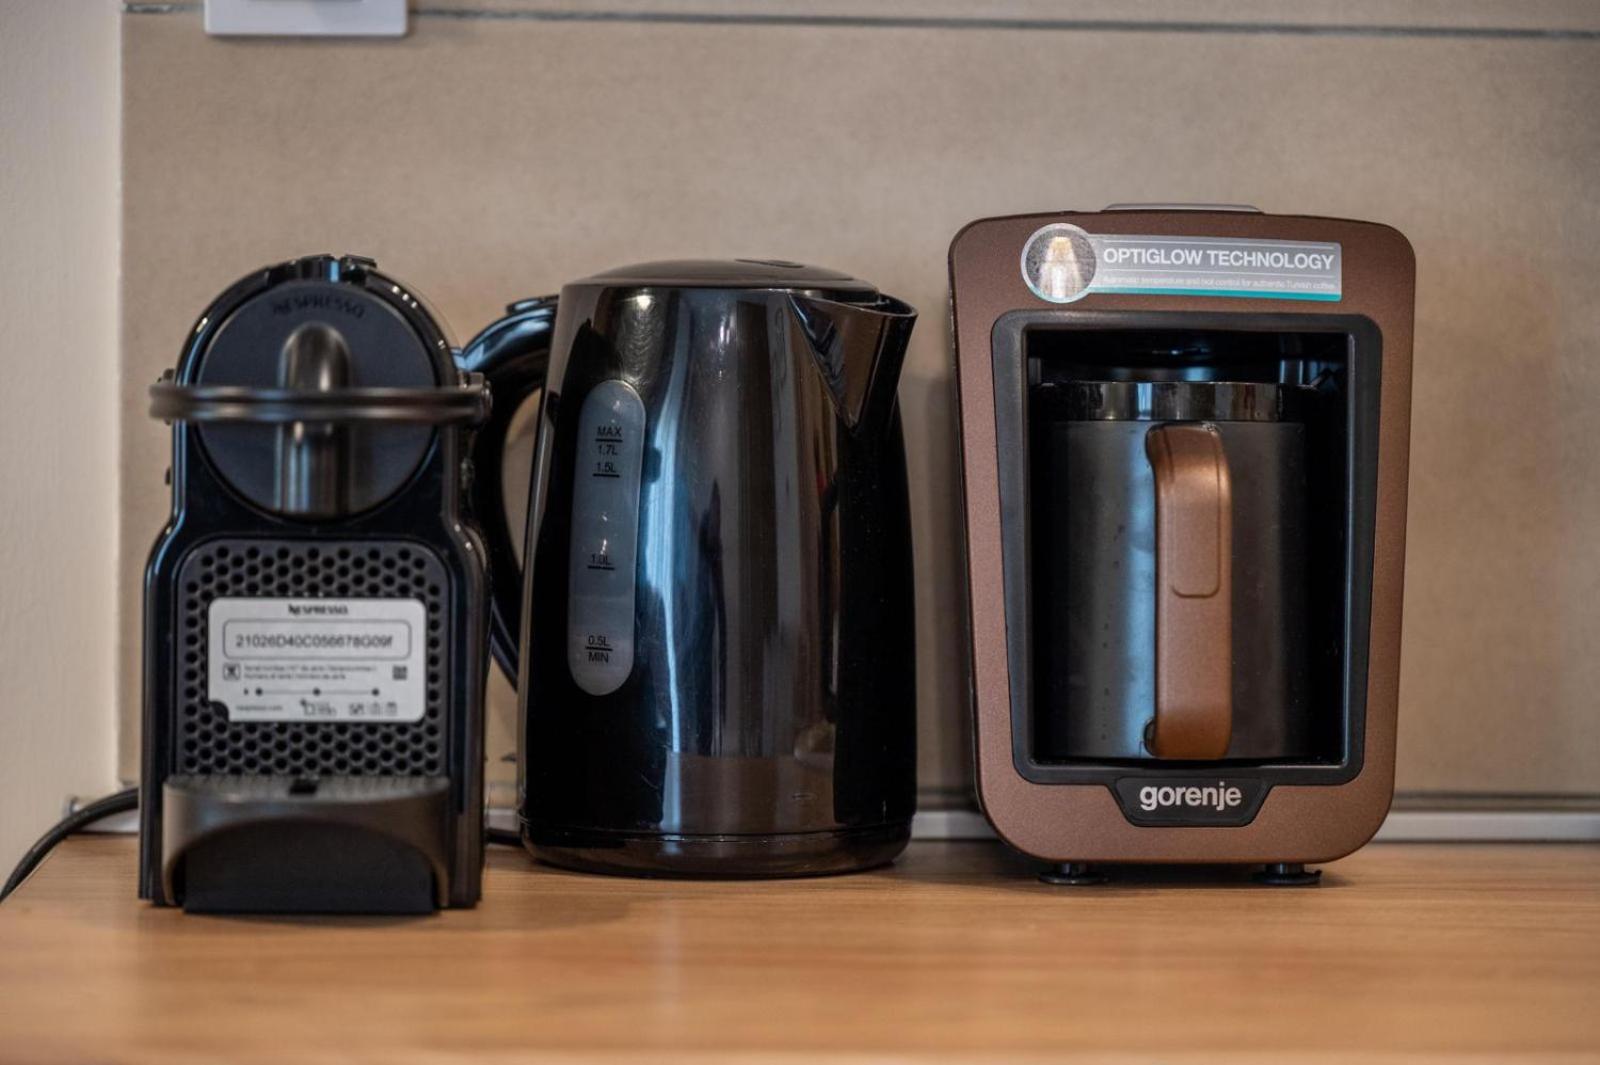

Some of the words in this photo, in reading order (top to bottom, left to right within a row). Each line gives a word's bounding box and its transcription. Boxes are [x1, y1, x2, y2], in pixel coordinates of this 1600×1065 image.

[1102, 247, 1203, 265] OPTIGLOW
[1206, 250, 1335, 270] TECHNOLOGY
[597, 426, 622, 437] MAX
[598, 444, 618, 456] 1.7L
[597, 462, 617, 473] 1.5L
[591, 554, 613, 565] 1.0L
[588, 635, 611, 647] 0.5L
[588, 652, 609, 662] MIN
[1139, 781, 1242, 811] gorenje
